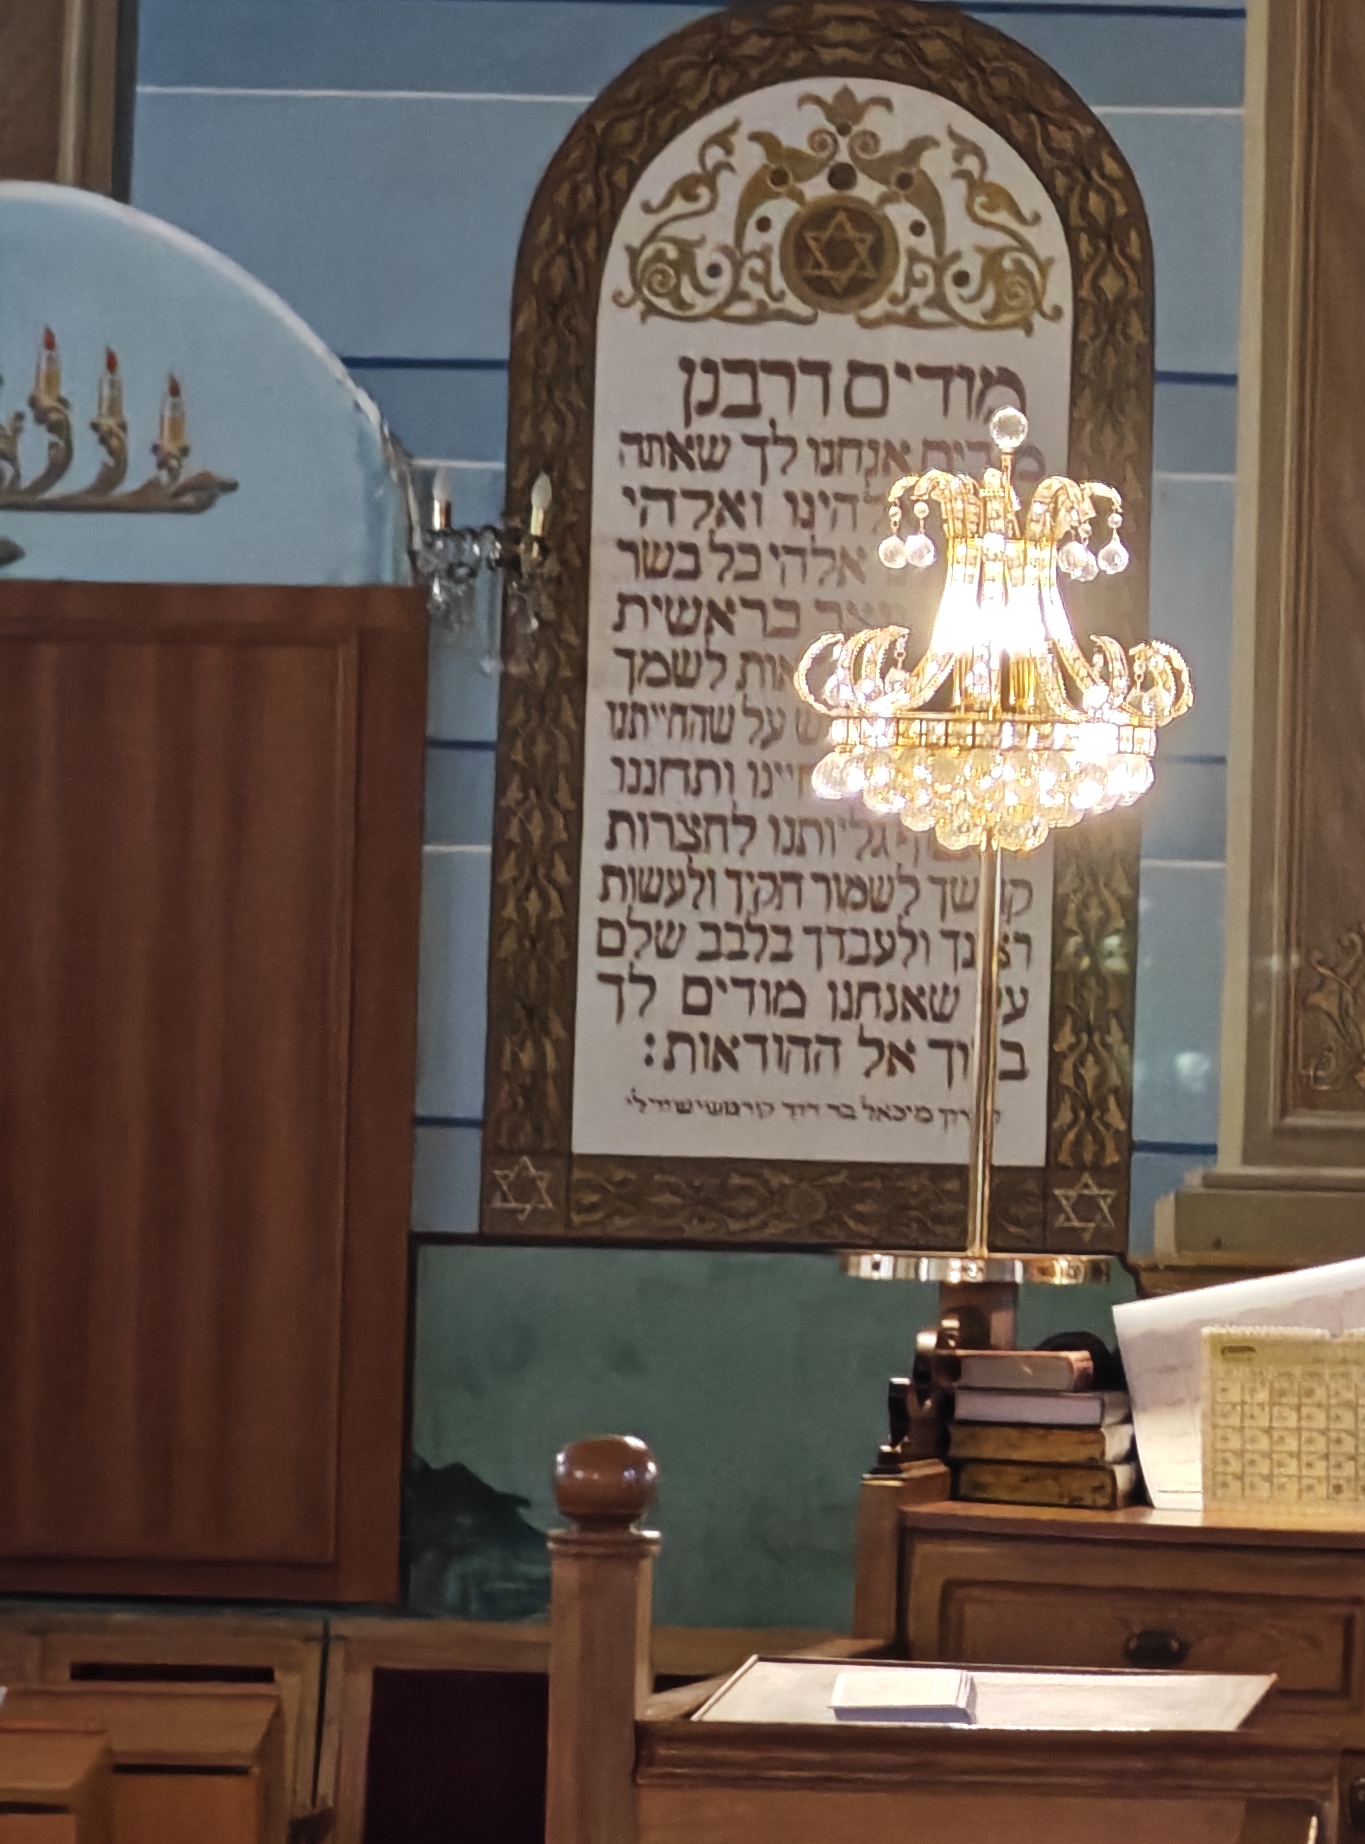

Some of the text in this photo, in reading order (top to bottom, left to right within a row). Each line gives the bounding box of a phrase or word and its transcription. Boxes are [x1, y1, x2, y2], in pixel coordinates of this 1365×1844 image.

[678, 355, 1028, 429] מודים דרבנן
[619, 417, 1047, 488] מדים אנחנו לך שאתה
[621, 485, 764, 531] ואלהי
[615, 528, 868, 588] אלהי כל בשר
[611, 592, 803, 638] בראשית
[612, 630, 728, 697] לשמך
[604, 700, 736, 744] שהחייתנו
[741, 693, 786, 750] על
[610, 756, 736, 797] ותחננו
[604, 800, 758, 858] לחצרות
[598, 853, 1034, 925] קשך לשמור חקיך ולעשות
[596, 903, 687, 960] שלם
[696, 909, 793, 963] בלבב
[802, 913, 931, 971] ולעבדך
[596, 961, 657, 1025] לך
[681, 973, 807, 1020] מודים
[826, 979, 961, 1023] שאנחנו
[858, 1022, 916, 1079] אל
[926, 1037, 1029, 1090] בוך
[827, 1102, 858, 1121] בר
